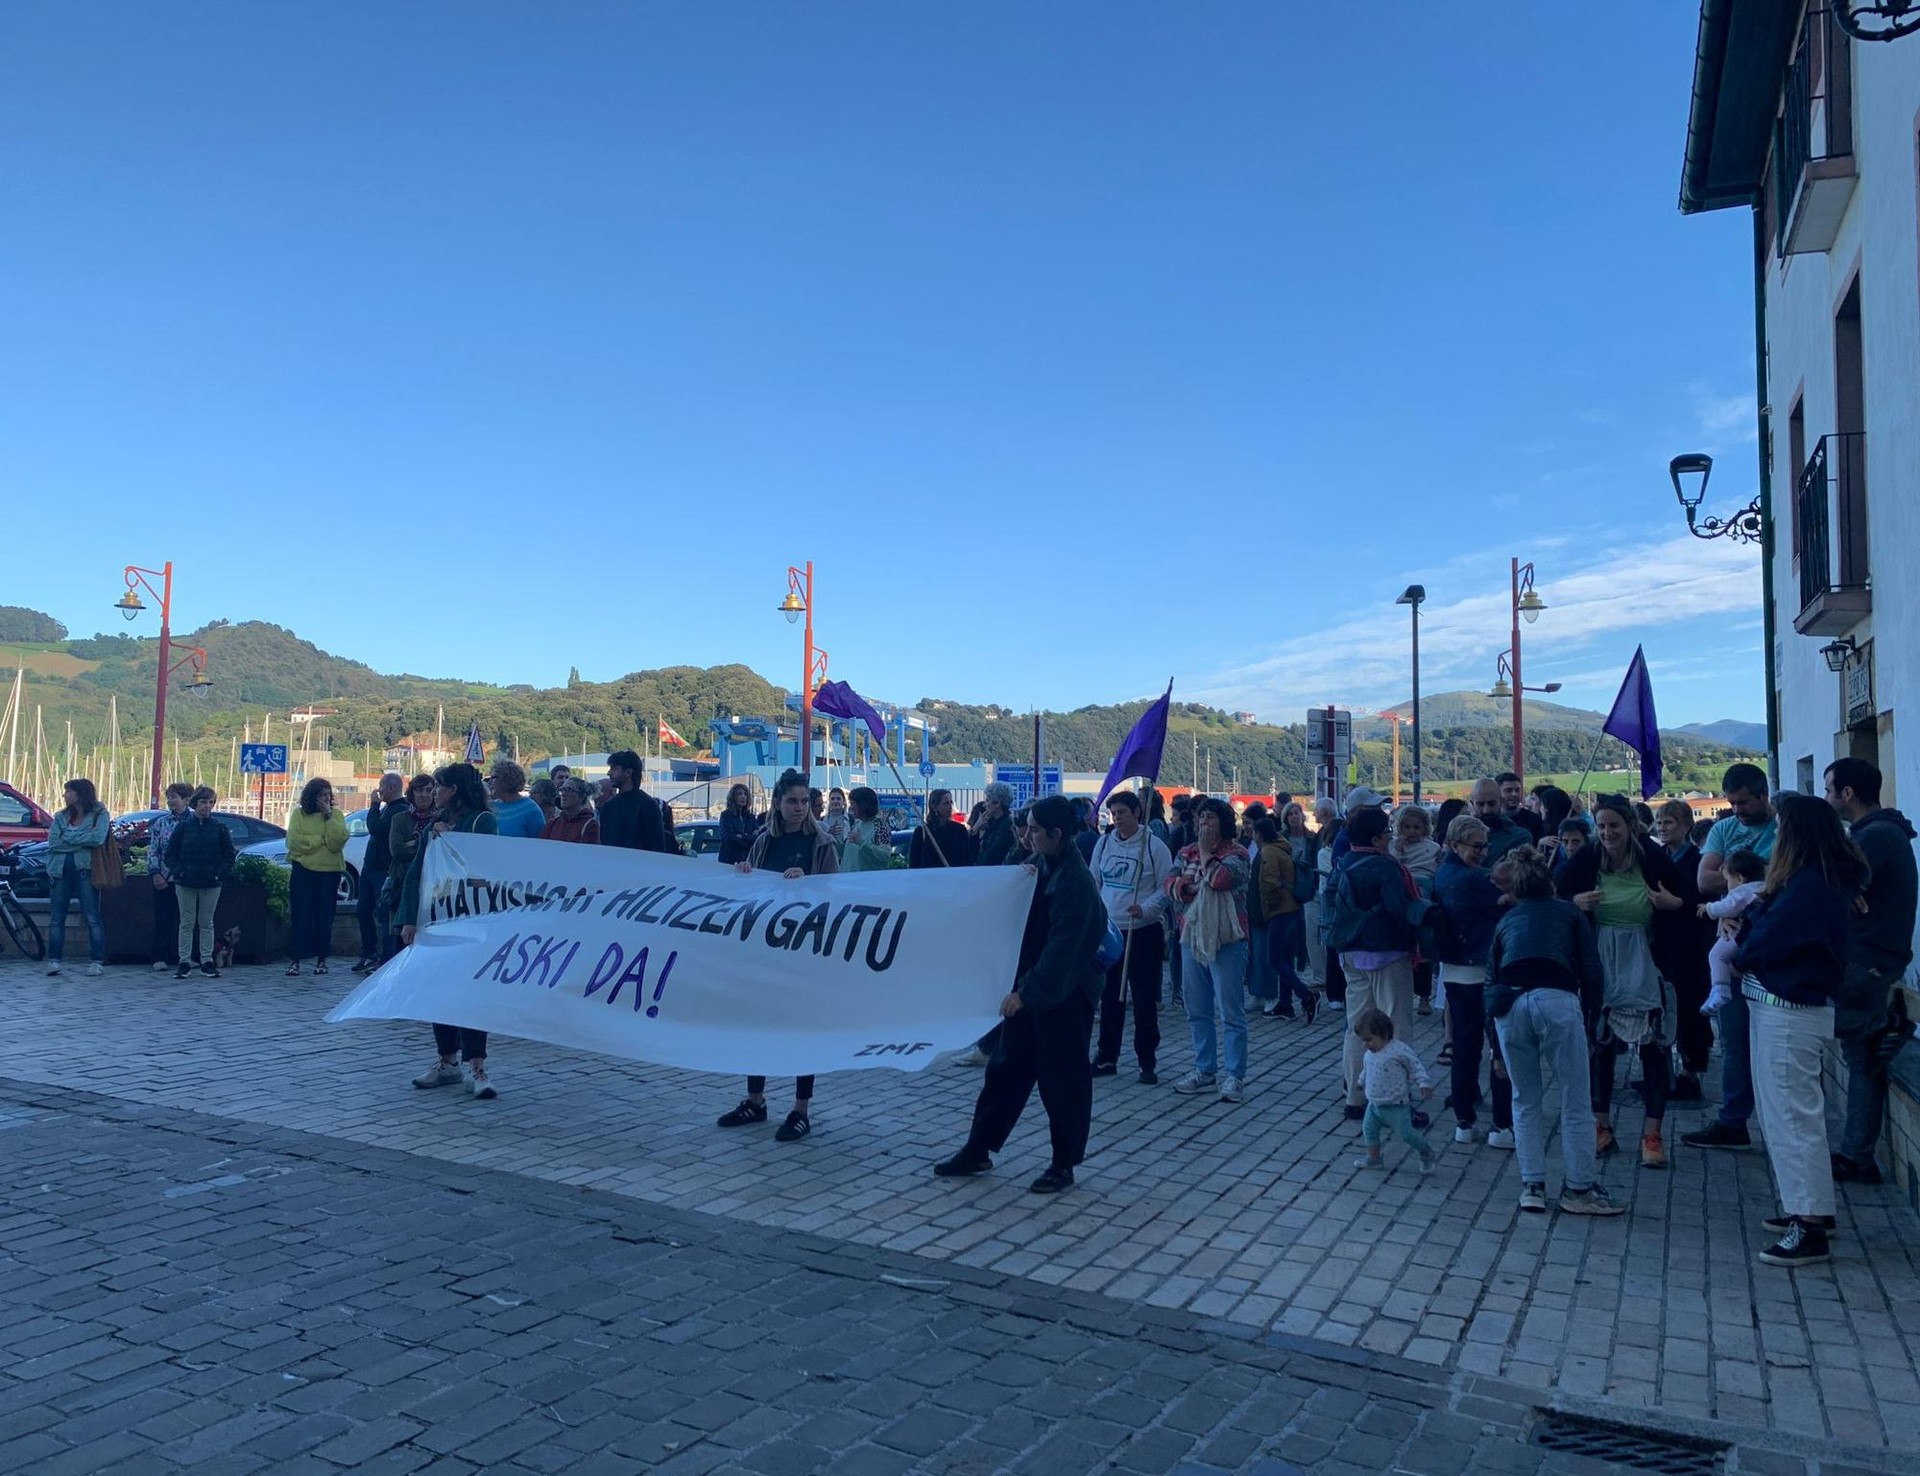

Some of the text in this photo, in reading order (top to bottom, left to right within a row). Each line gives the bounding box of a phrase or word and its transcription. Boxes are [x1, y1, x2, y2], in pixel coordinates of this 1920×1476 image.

[430, 877, 908, 972] MATXISMO HILTZEN GAITU
[473, 933, 678, 1018] ASKI DA!
[853, 1041, 934, 1057] ZMF
